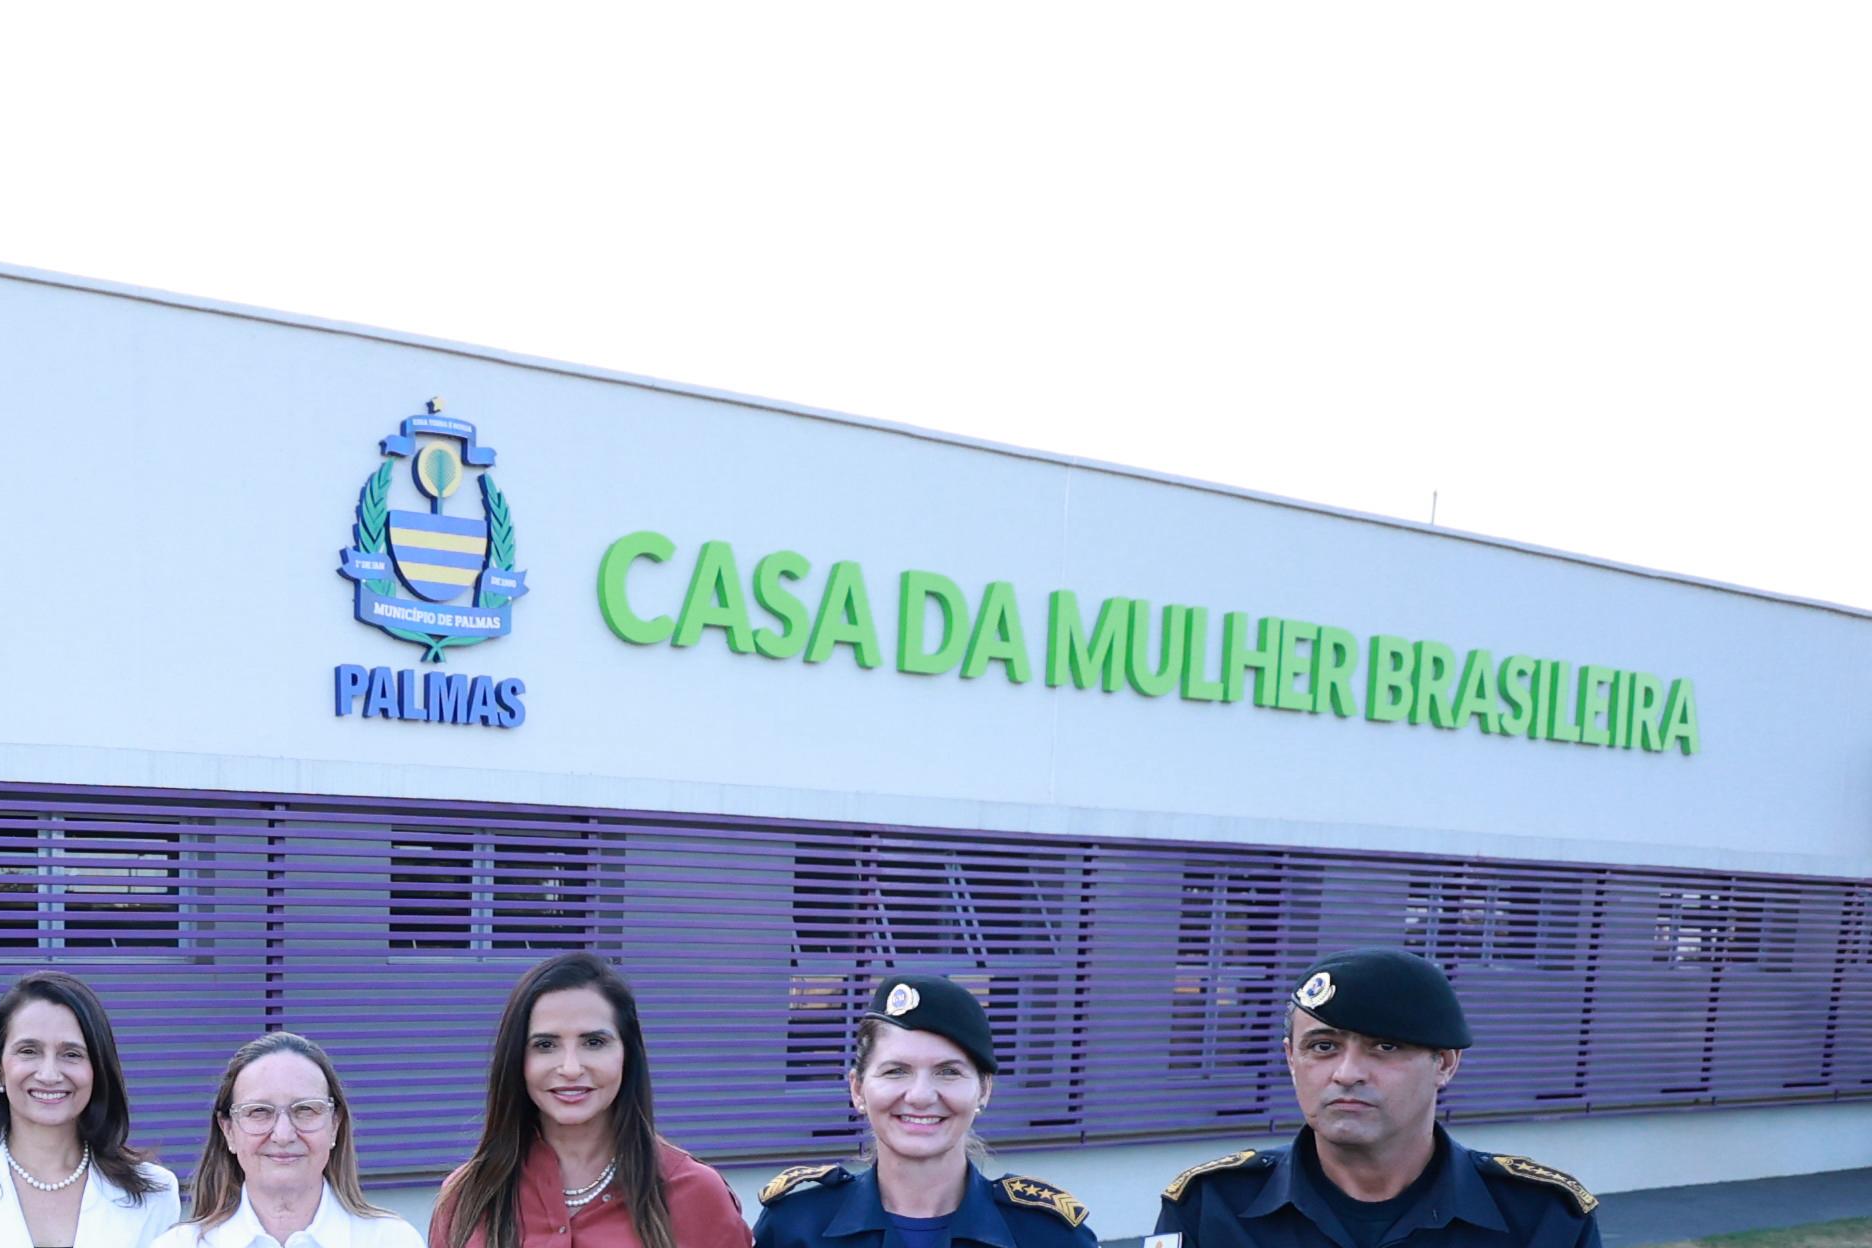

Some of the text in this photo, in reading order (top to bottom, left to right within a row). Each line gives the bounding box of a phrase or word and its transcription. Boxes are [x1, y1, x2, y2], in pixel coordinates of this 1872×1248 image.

[373, 602, 501, 629] MUNICÍPIO DE PALMAS
[598, 531, 1699, 755] CASA DA MULHER BRASILEIRA
[334, 664, 526, 728] PALMAS
